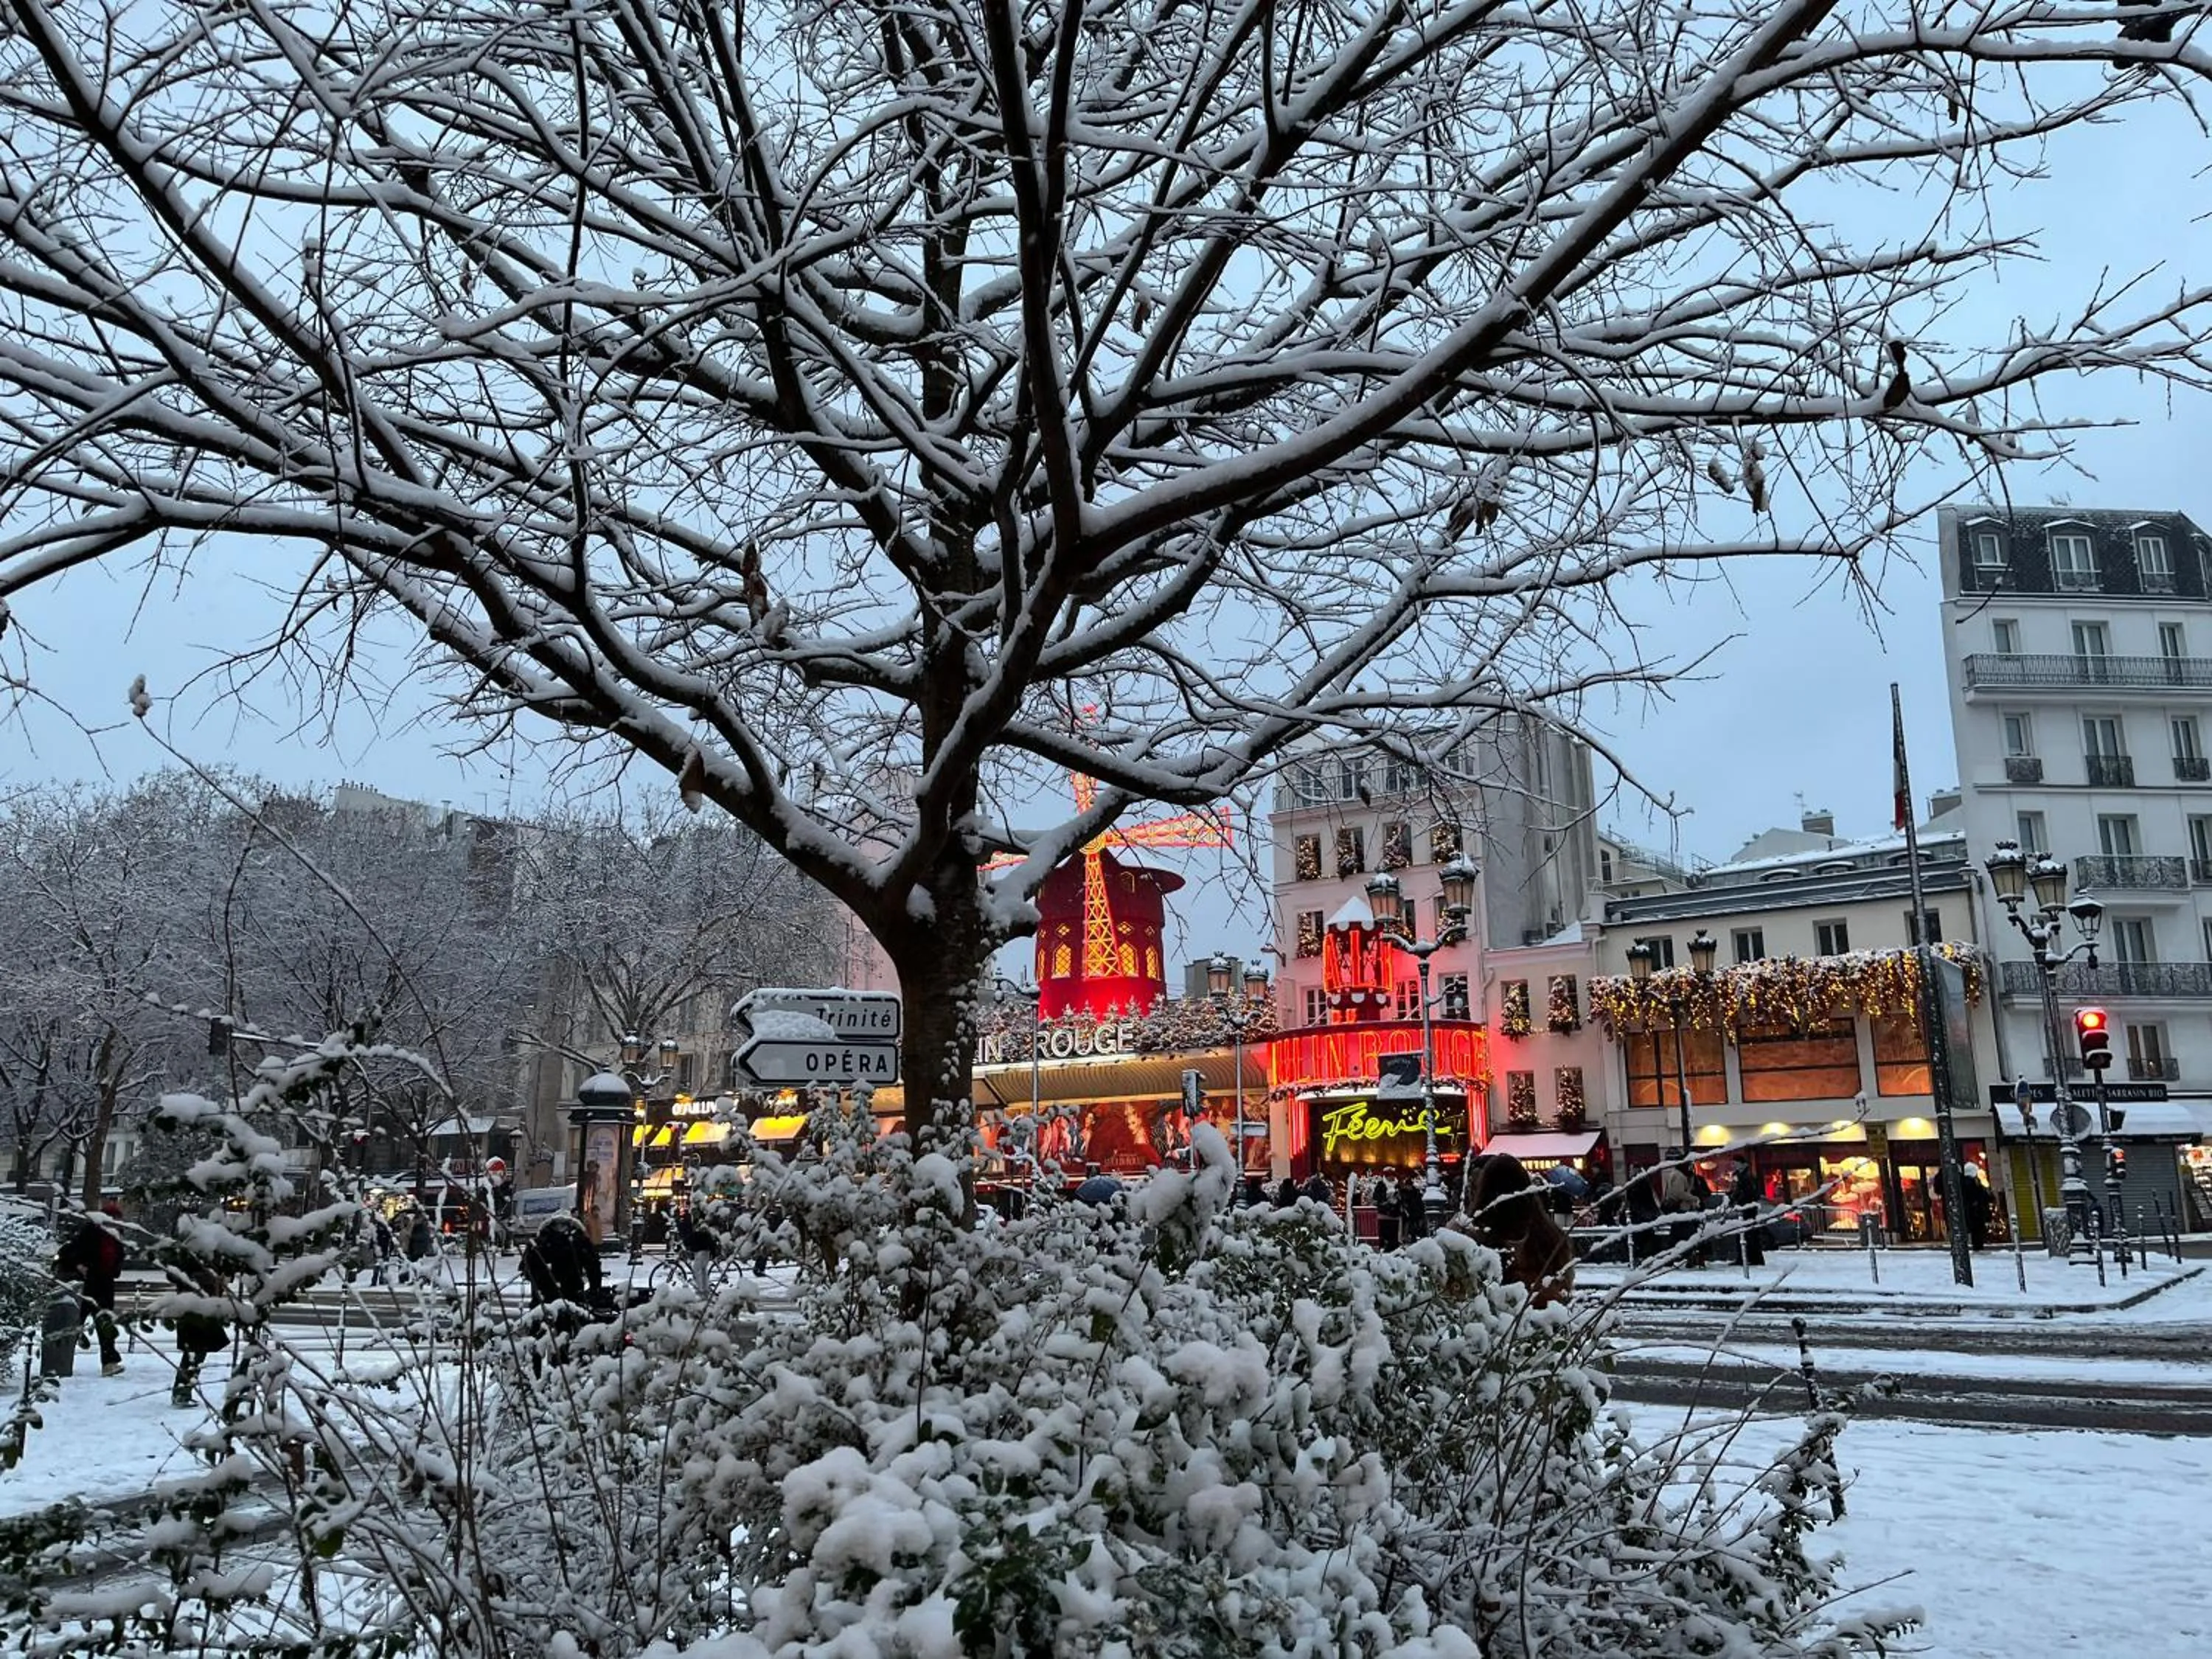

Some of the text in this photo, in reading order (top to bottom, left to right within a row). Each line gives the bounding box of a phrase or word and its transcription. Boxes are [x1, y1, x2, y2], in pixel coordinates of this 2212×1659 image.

[816, 1008, 892, 1027] Trinité
[1036, 1022, 1135, 1057] ROUGE
[805, 1049, 888, 1073] OPÉRA
